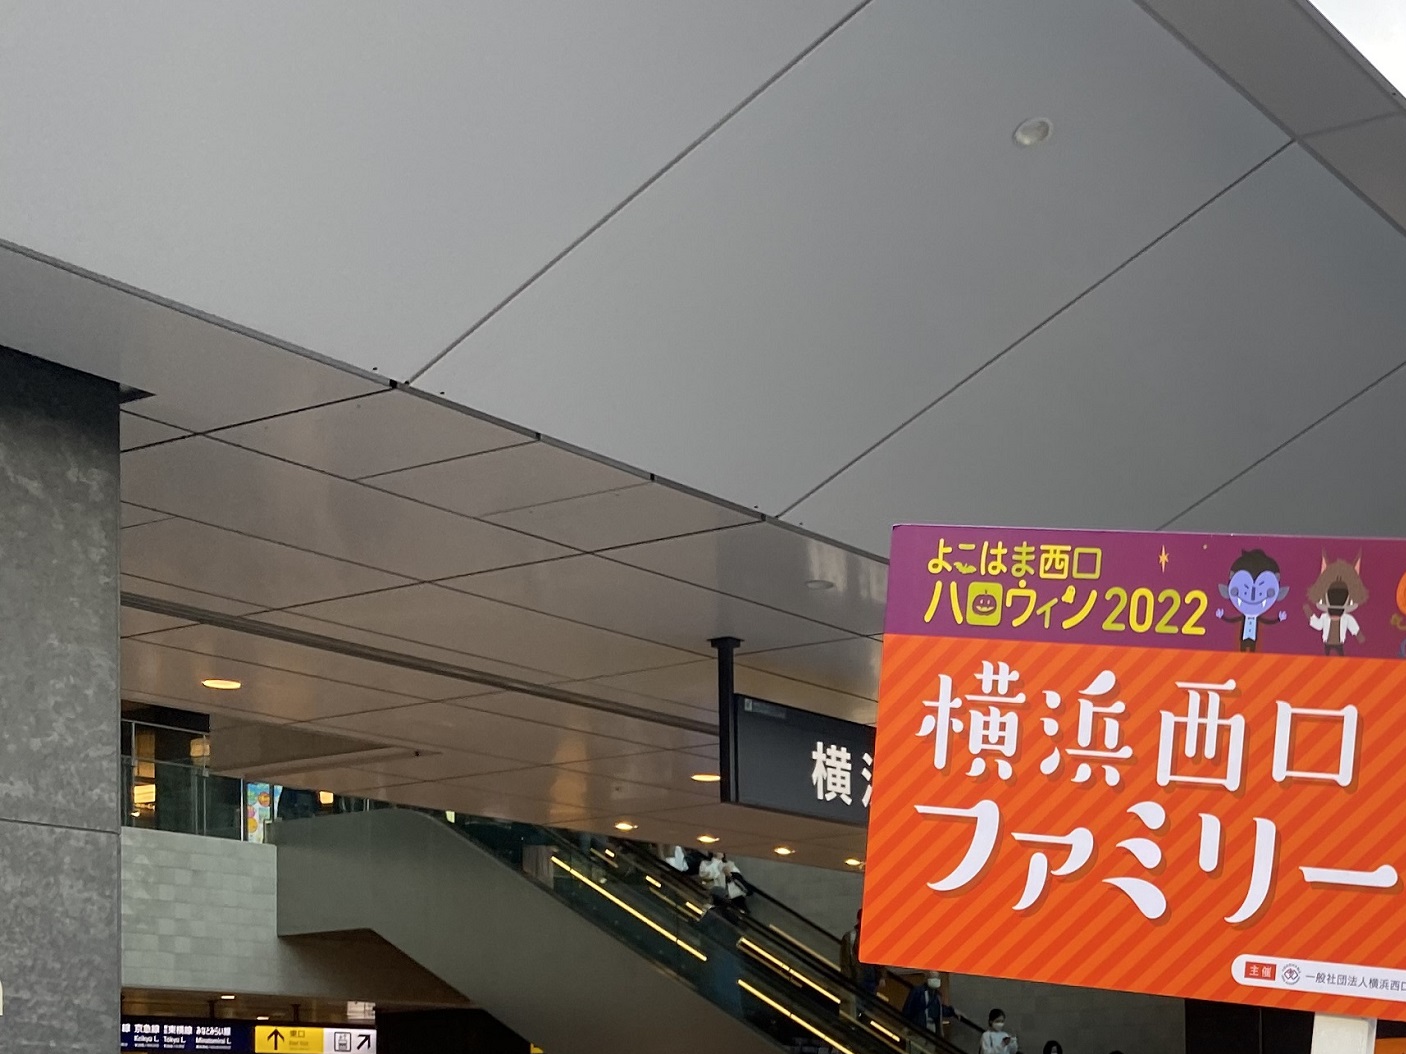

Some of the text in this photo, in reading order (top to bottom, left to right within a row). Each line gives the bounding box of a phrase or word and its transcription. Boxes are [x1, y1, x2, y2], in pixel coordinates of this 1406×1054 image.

[926, 538, 1103, 580] よこはま西口
[915, 660, 1360, 793] 横浜西口
[1248, 964, 1272, 979] 主催
